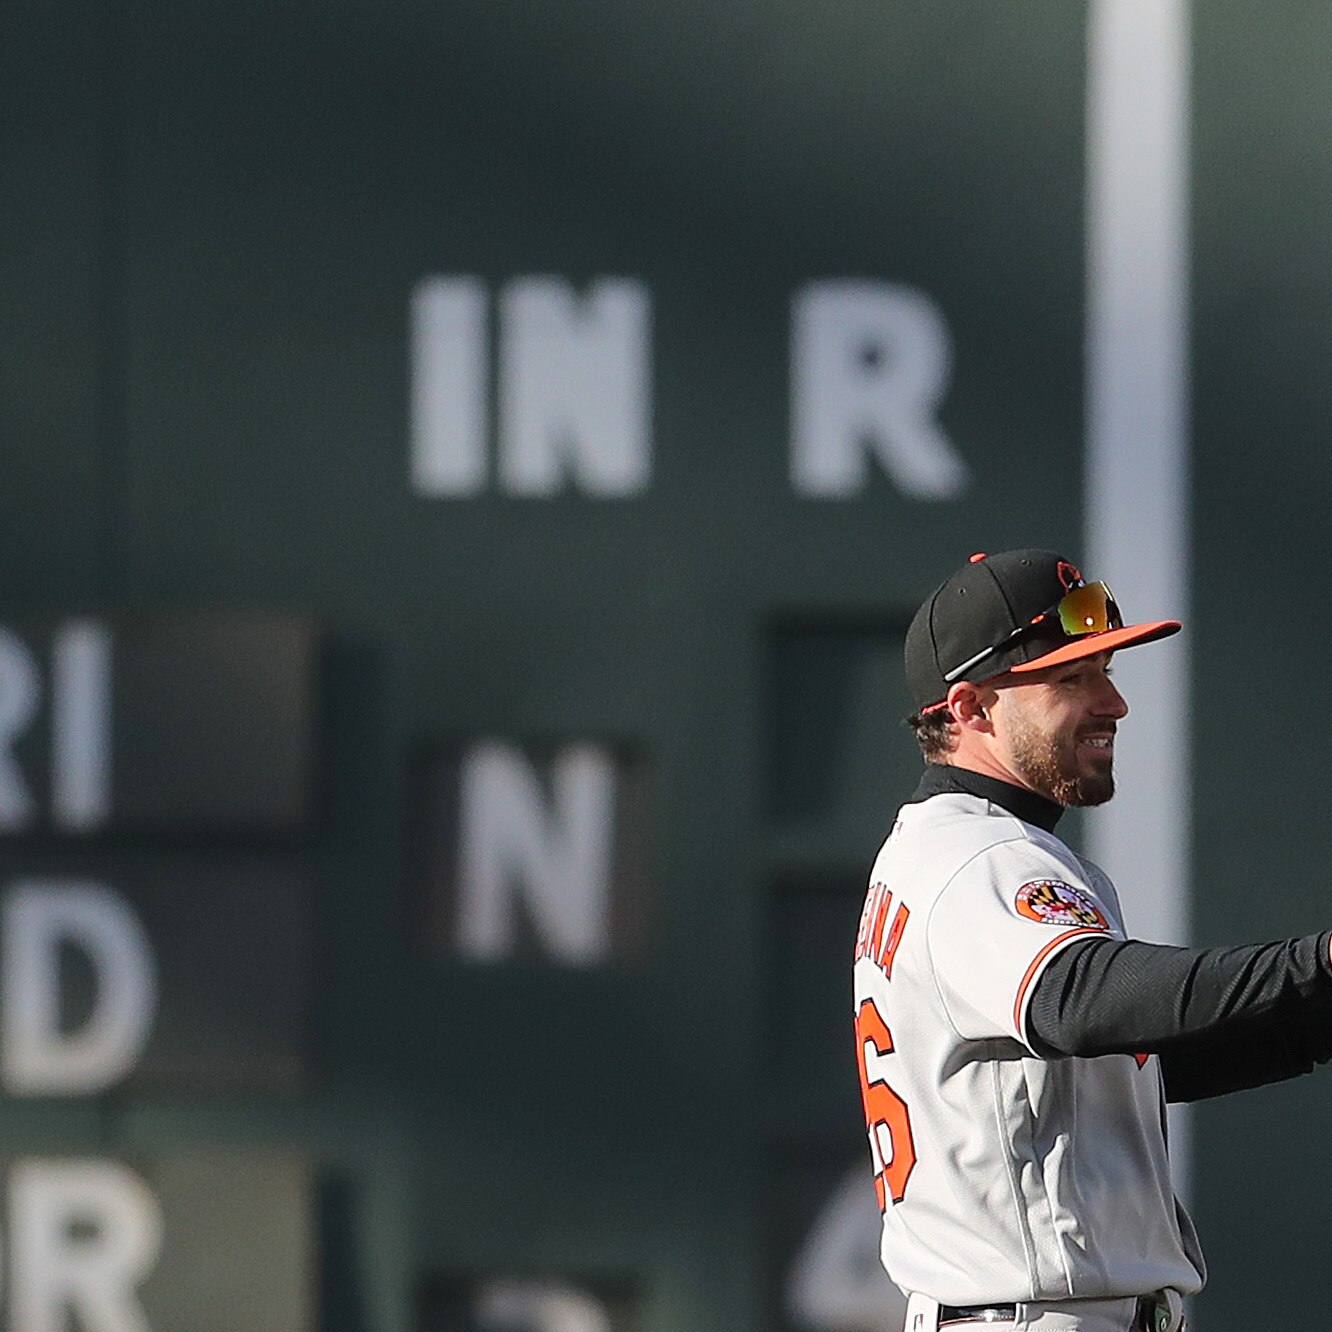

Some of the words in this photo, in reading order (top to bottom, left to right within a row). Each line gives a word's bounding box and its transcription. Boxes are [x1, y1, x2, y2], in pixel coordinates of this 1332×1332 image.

[410, 273, 652, 499] IN
[790, 278, 967, 499] R
[455, 738, 614, 962] N
[854, 996, 917, 1213] 6
